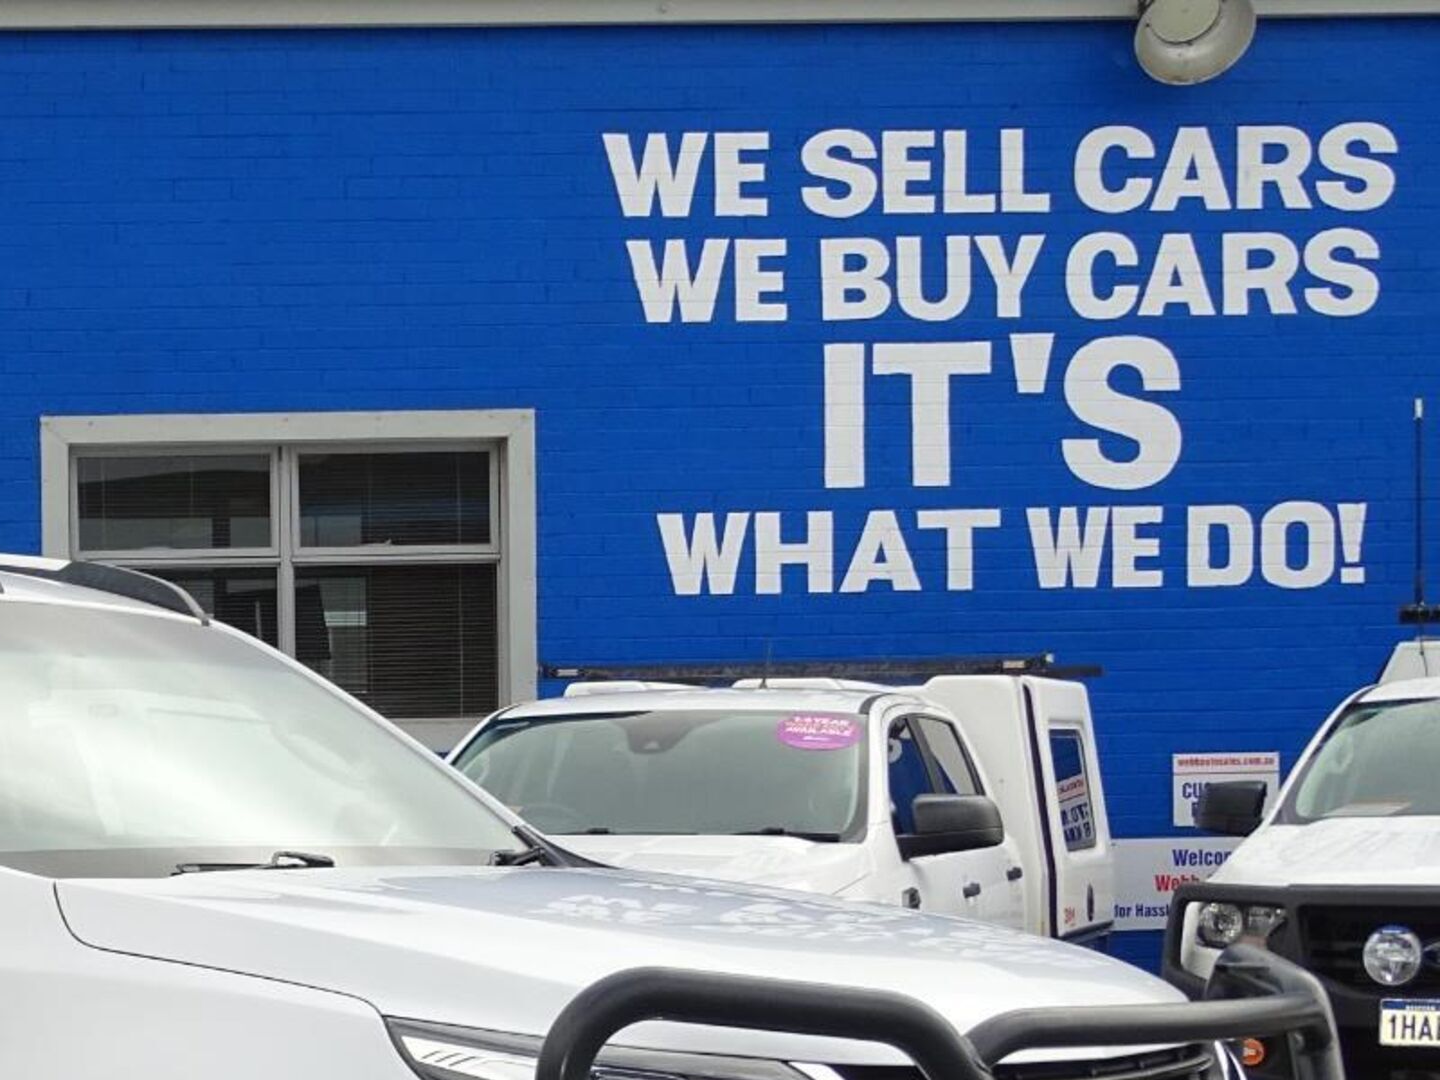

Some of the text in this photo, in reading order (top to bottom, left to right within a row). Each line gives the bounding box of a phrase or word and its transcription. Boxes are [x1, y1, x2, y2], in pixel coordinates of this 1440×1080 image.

[603, 122, 1398, 217] WE SELL CARS
[626, 227, 1380, 322] WE BUY CARS
[823, 332, 1182, 489] IT'S
[656, 501, 1367, 595] WHAT WE DO!
[1114, 904, 1132, 918] for
[1389, 1014, 1440, 1041] 1HA
